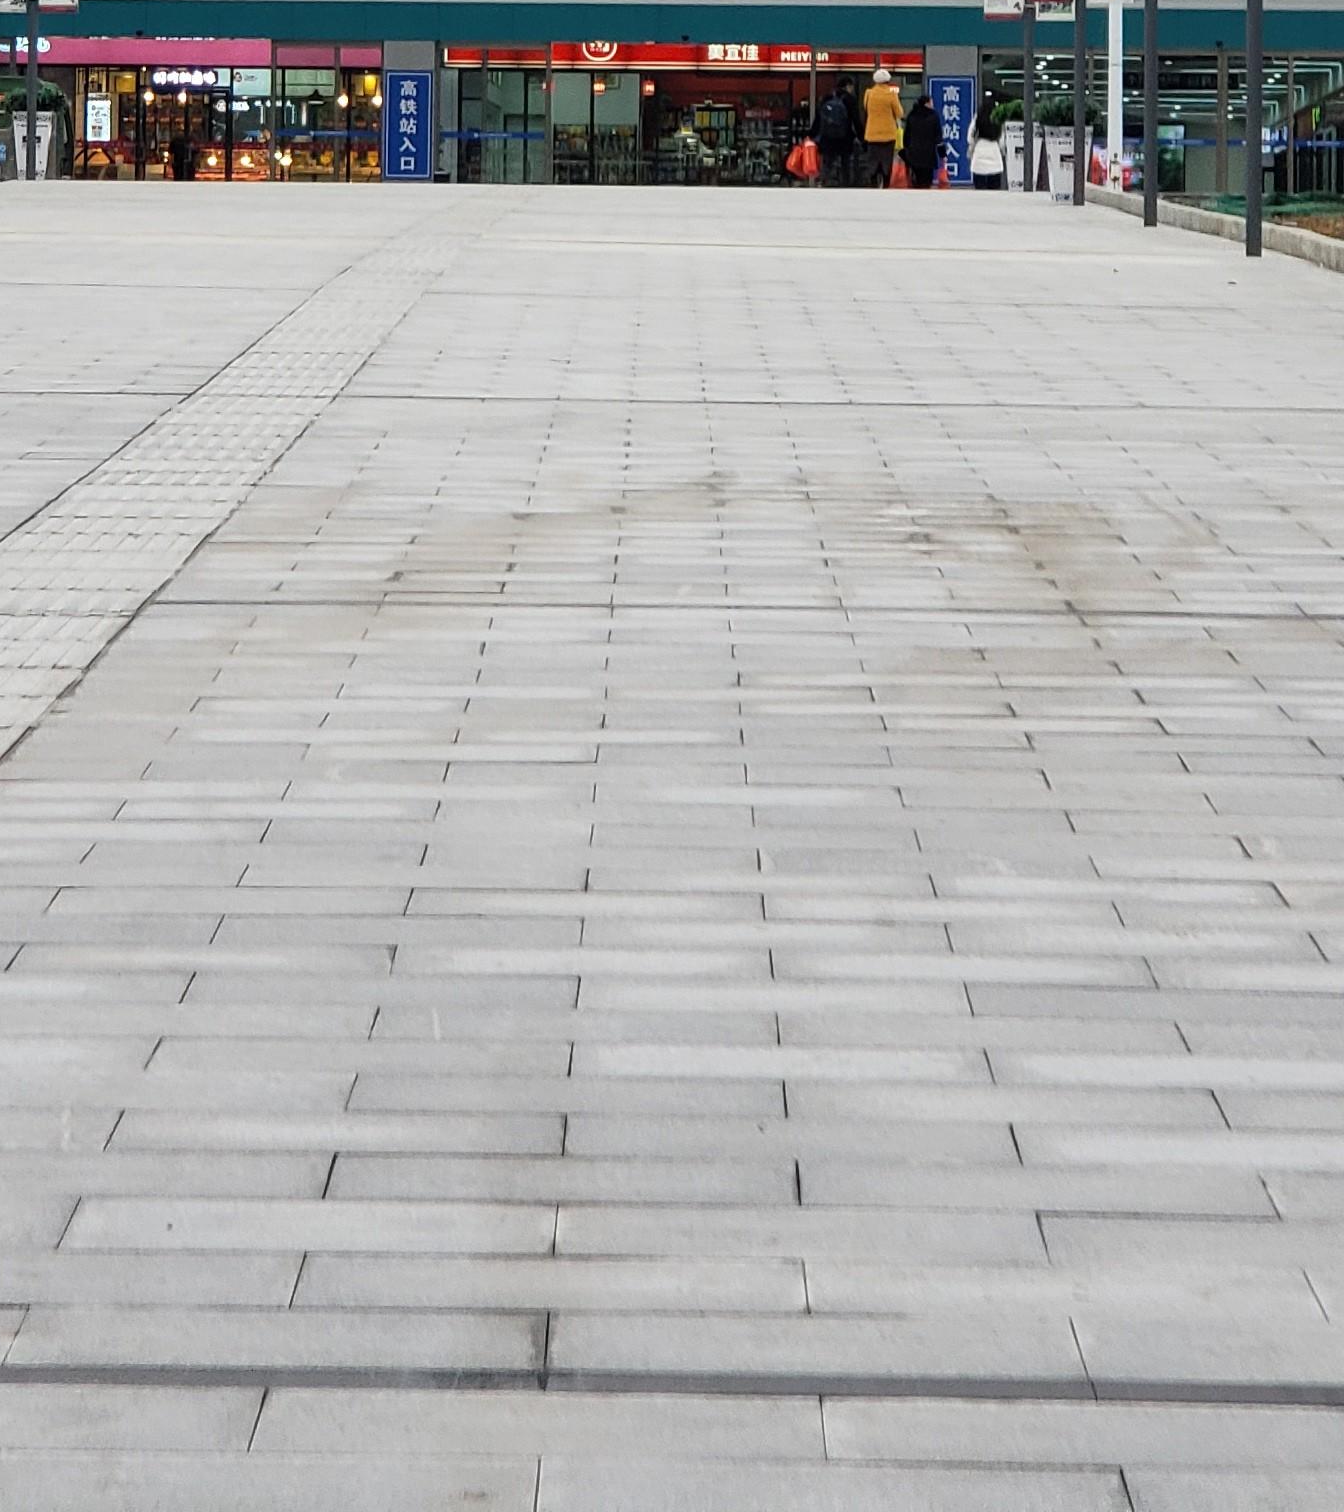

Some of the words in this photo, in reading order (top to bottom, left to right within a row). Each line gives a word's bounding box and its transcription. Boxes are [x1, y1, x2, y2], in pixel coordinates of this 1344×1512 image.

[707, 44, 759, 61] 美宜佳
[399, 80, 418, 171] 高铁站入口
[942, 85, 961, 177] 高铁站入口
